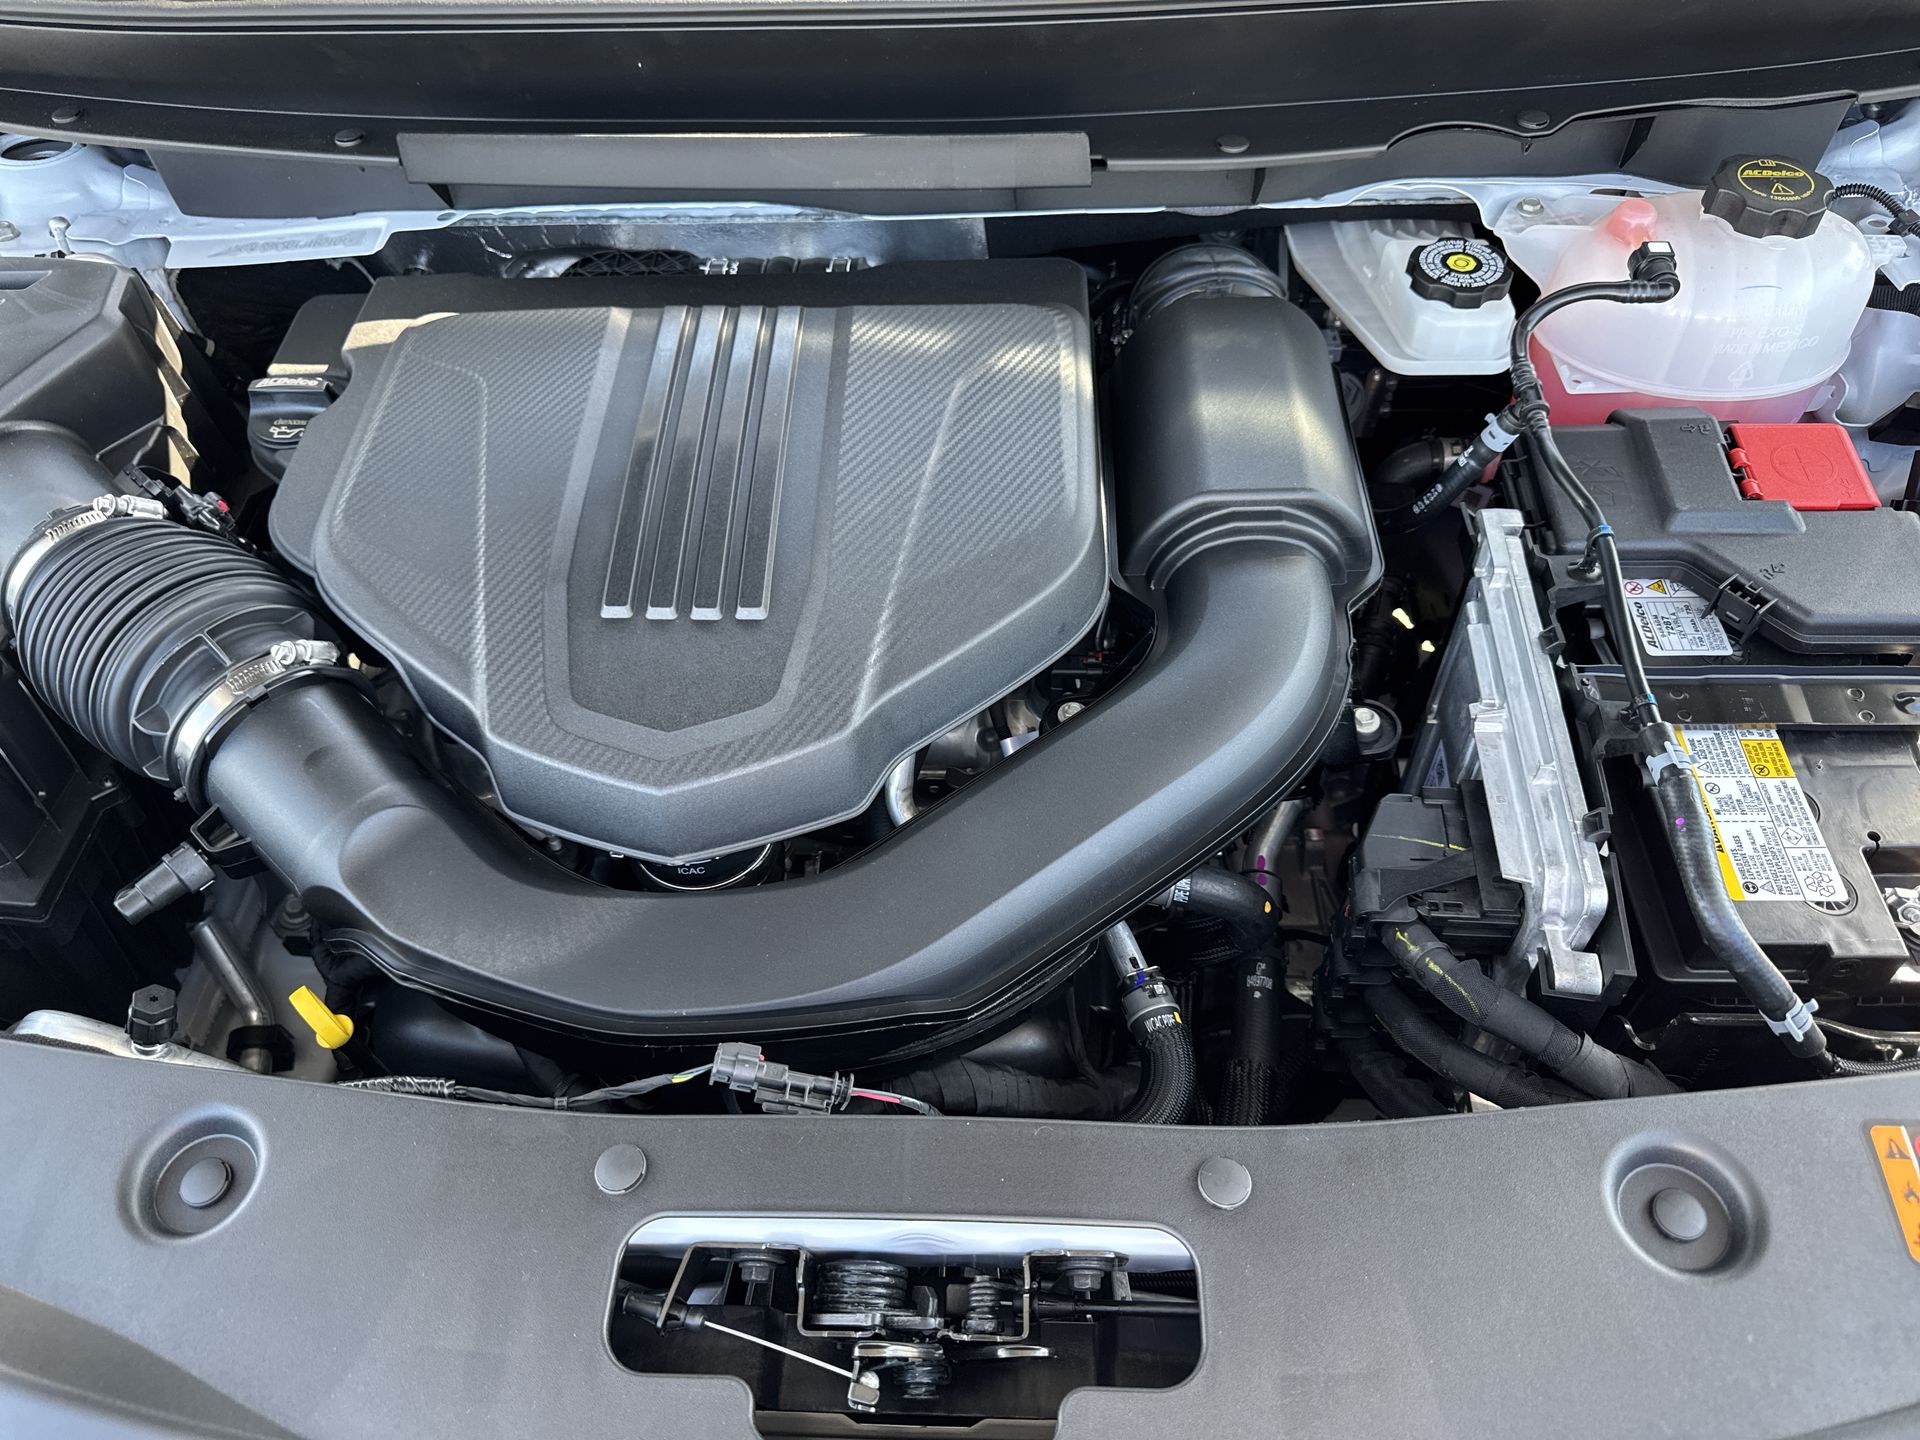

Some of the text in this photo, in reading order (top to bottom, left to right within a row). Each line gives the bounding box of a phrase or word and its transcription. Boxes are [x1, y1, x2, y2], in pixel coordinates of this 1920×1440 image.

[1741, 169, 1805, 178] ACDelco
[1712, 343, 1748, 354] MADE
[1763, 336, 1820, 353] MEXICO
[256, 377, 319, 388] ACDelco
[1634, 602, 1658, 648] ACDelco
[1669, 612, 1686, 639] 12V VRLA
[1713, 732, 1729, 757] SULFURIQUE
[1699, 749, 1708, 759] ACID
[1702, 737, 1721, 774] CAUSE BLINDNESS
[1715, 752, 1725, 767] SEVERE
[1728, 747, 1738, 762] CAUSER
[1734, 764, 1743, 774] PEUT
[1744, 784, 1755, 803] FLAMMES
[1760, 783, 1773, 804] IMMEDIATELY
[1726, 794, 1738, 812] SMOKING
[1774, 815, 1782, 827] FLUSH
[1760, 825, 1793, 895] LES GAZ EXPLOSIFS PEUVENT
[1765, 859, 1774, 867] LES
[1776, 848, 1787, 865] RENDRE
[1792, 856, 1801, 871] BATTERY
[677, 866, 706, 875] ICAC
[1736, 863, 1748, 879] SHIELD
[1739, 853, 1755, 879] EXPLOSIVE
[1748, 855, 1763, 879] CAN CAUSE
[1755, 855, 1770, 879] BLINDNESS
[1787, 874, 1800, 895] BLESSER
